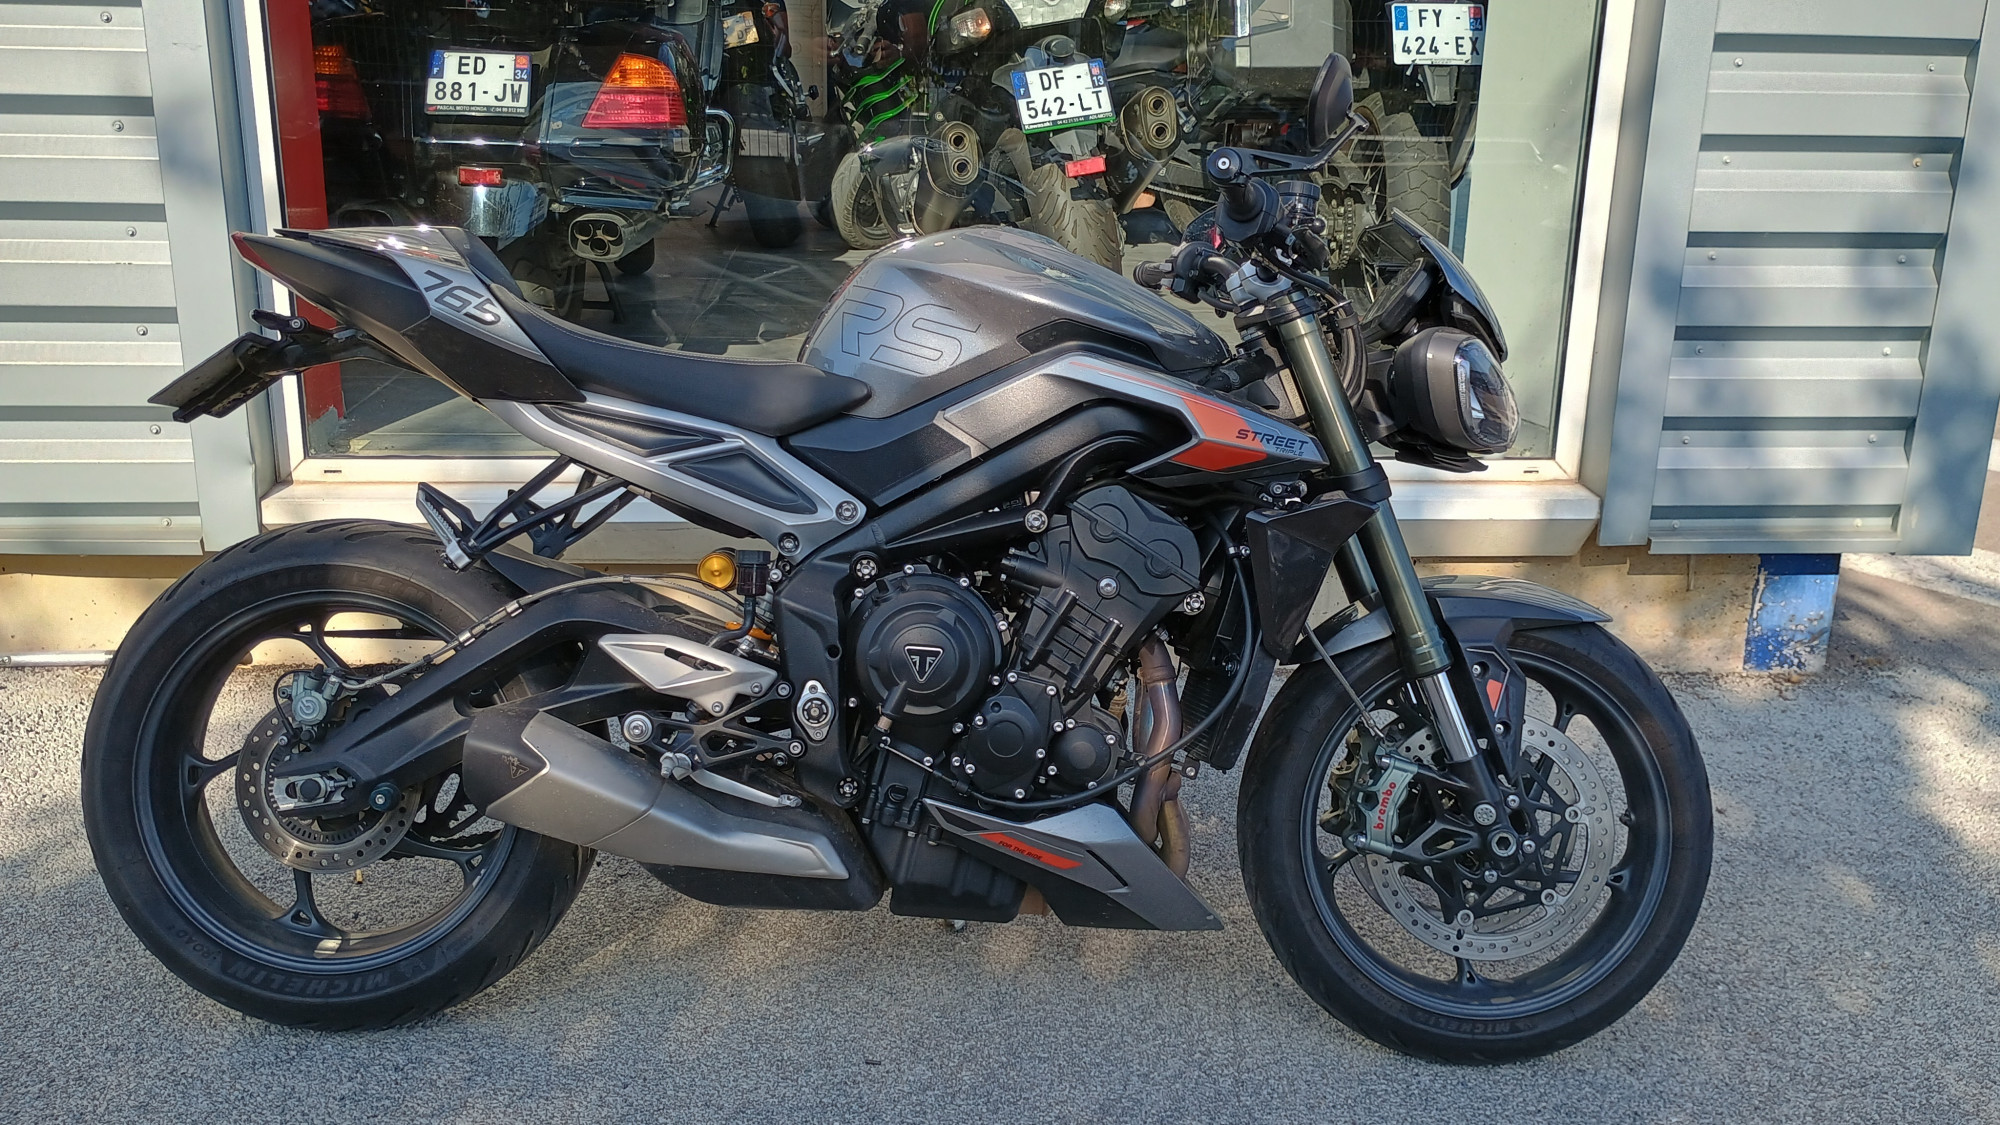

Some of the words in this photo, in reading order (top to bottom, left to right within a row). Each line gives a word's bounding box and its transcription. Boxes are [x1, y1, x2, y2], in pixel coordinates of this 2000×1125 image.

[1398, 21, 1405, 29] F
[1418, 9, 1442, 28] FY
[1469, 19, 1482, 30] 34
[1401, 36, 1480, 56] 424-EX
[433, 67, 440, 75] F
[457, 55, 487, 75] ED
[514, 69, 528, 80] 34
[1038, 69, 1065, 91] DF
[1092, 75, 1104, 87] 13
[434, 81, 523, 103] 881-JW
[1019, 87, 1026, 96] F
[1025, 90, 1103, 119] 542-LT
[1024, 120, 1053, 130] Kawasaki
[423, 269, 501, 326] 765
[841, 284, 982, 375] RS
[1235, 428, 1309, 450] STREET
[1274, 446, 1304, 457] TRIPLE
[1373, 781, 1397, 831] brembo
[998, 840, 1013, 849] FOR
[1012, 846, 1027, 855] THE
[1025, 851, 1043, 861] RIDE
[225, 960, 392, 996] MICHELIN
[1414, 1010, 1511, 1034] MICHELIN
